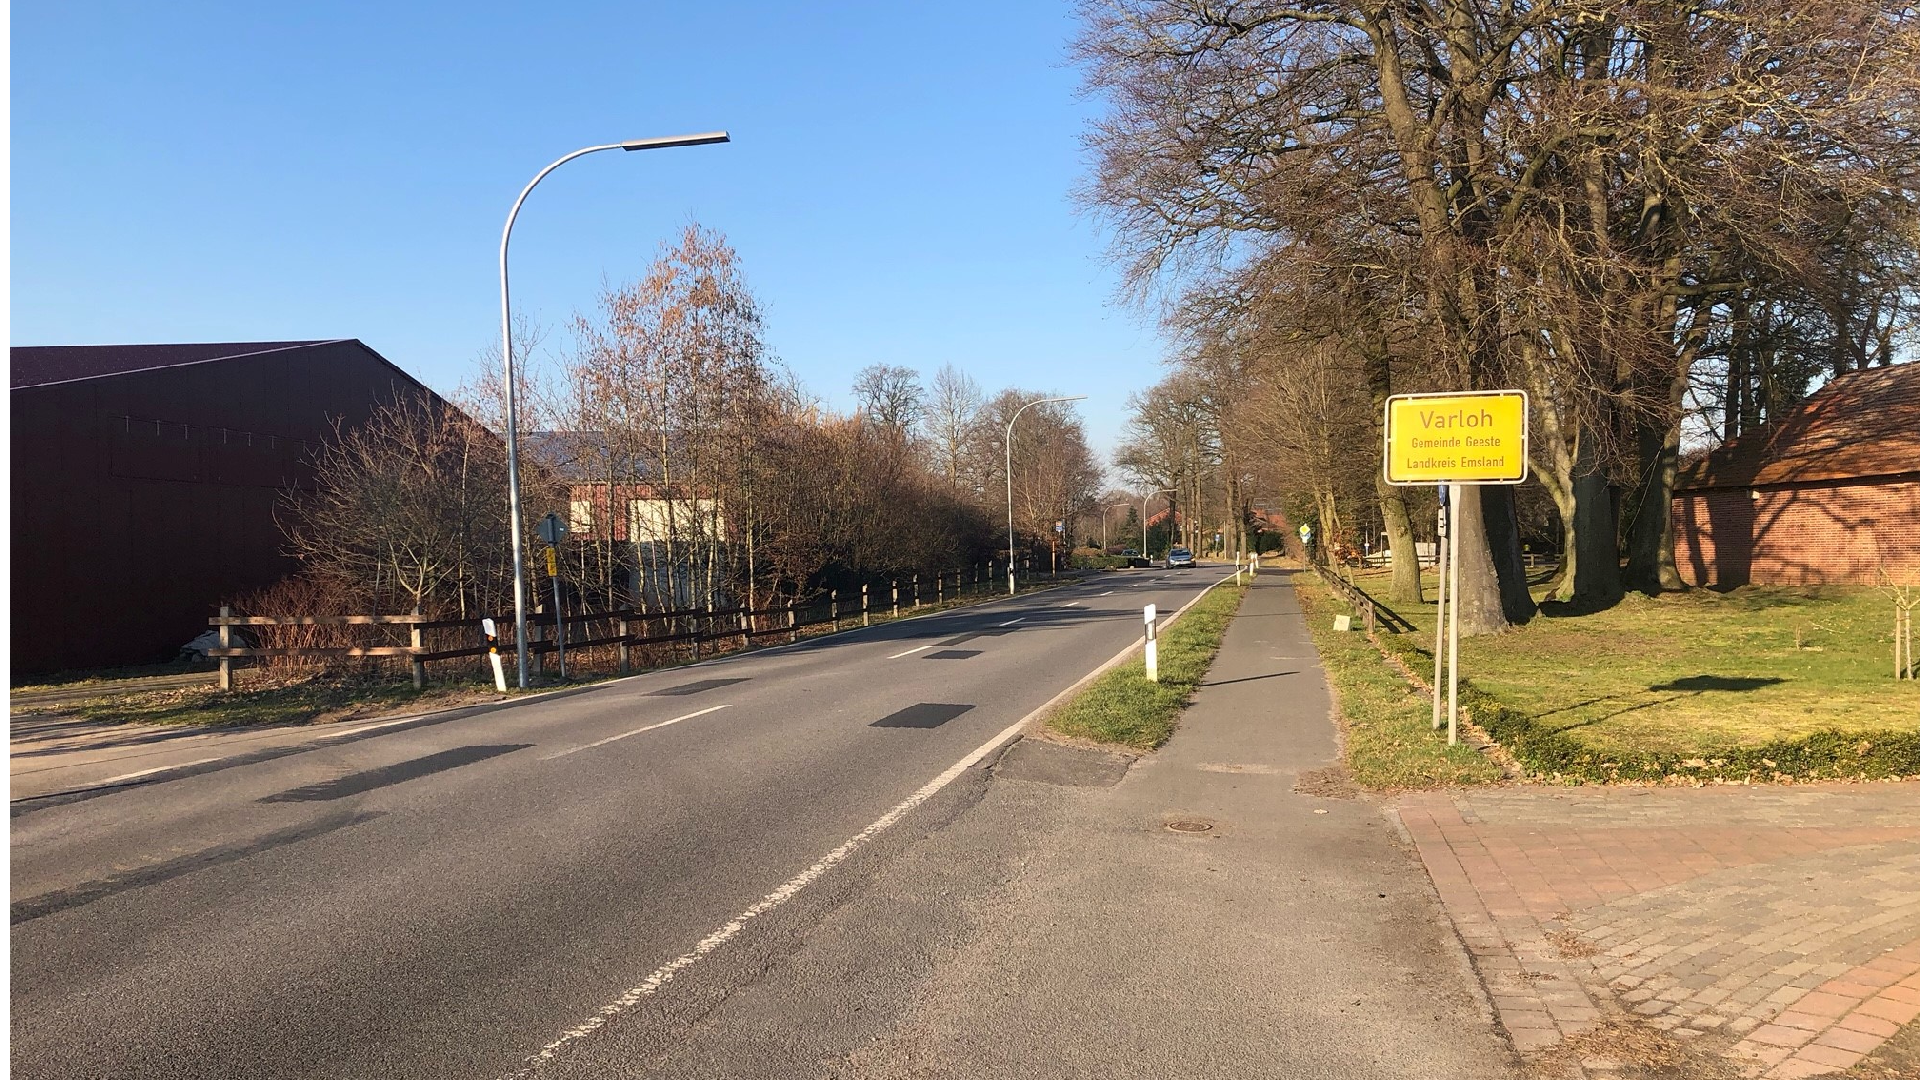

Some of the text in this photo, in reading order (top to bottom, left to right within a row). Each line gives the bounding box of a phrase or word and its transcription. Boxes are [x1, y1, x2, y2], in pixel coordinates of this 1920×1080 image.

[1420, 409, 1493, 429] Varloh
[1411, 436, 1501, 448] Gemeinde Geeste
[1407, 456, 1504, 469] Landkreis Emsland
